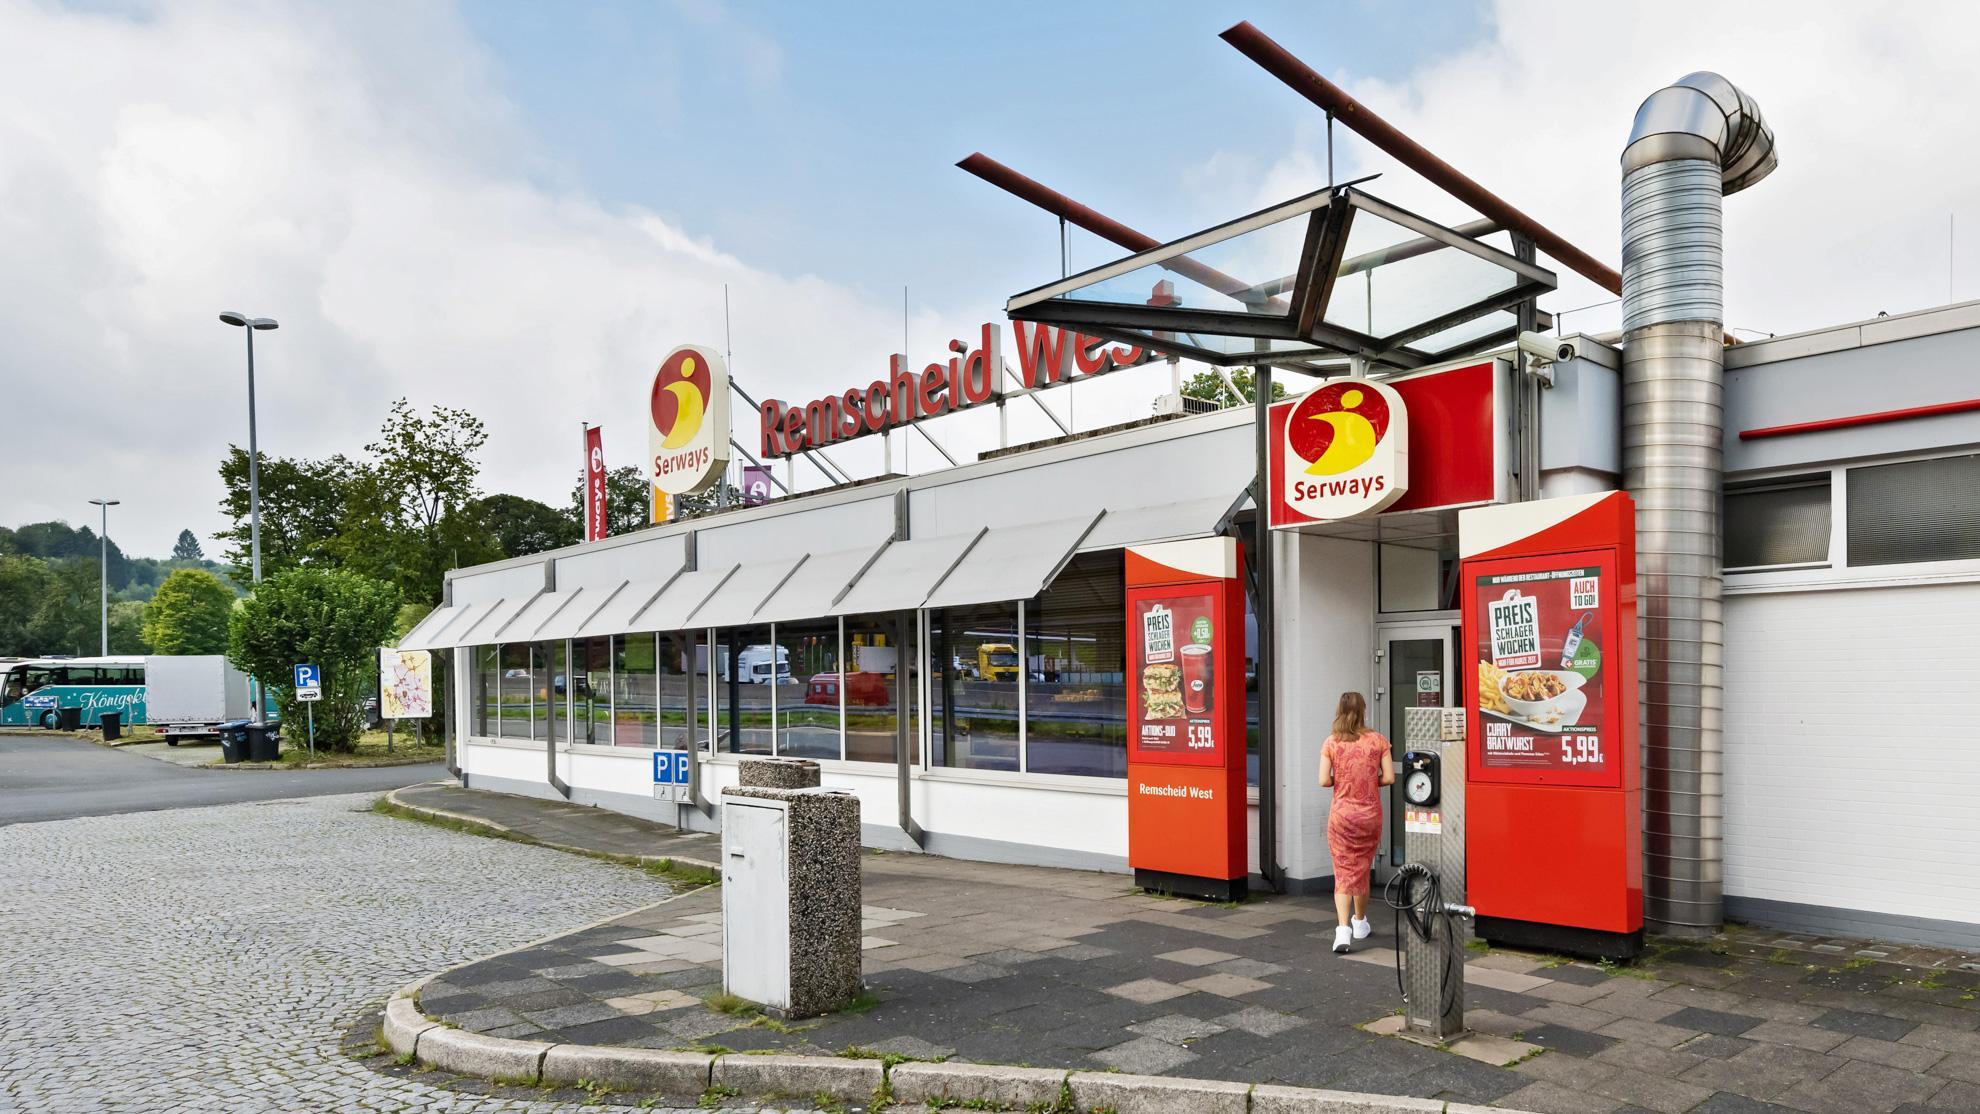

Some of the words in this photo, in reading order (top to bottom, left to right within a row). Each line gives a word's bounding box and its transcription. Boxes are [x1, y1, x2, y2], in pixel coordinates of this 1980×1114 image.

[761, 323, 996, 458] Remscheid
[655, 446, 709, 477] Serways
[1294, 475, 1384, 501] Serways
[1574, 579, 1595, 594] AUCH
[1574, 596, 1582, 606] TO
[1147, 614, 1169, 631] PREIS
[1494, 602, 1533, 627] PREIS
[1496, 624, 1534, 641] SCHLAGER
[1149, 640, 1171, 651] WOCHEN
[1497, 637, 1536, 655] WOCHEN
[299, 667, 312, 685] P
[80, 688, 146, 710] Königsk
[1486, 722, 1512, 737] CURRY
[1487, 736, 1534, 751] BRATWURST
[658, 756, 668, 779] P
[679, 757, 688, 780] P
[1139, 783, 1187, 797] Remscheid
[1189, 787, 1213, 799] West
